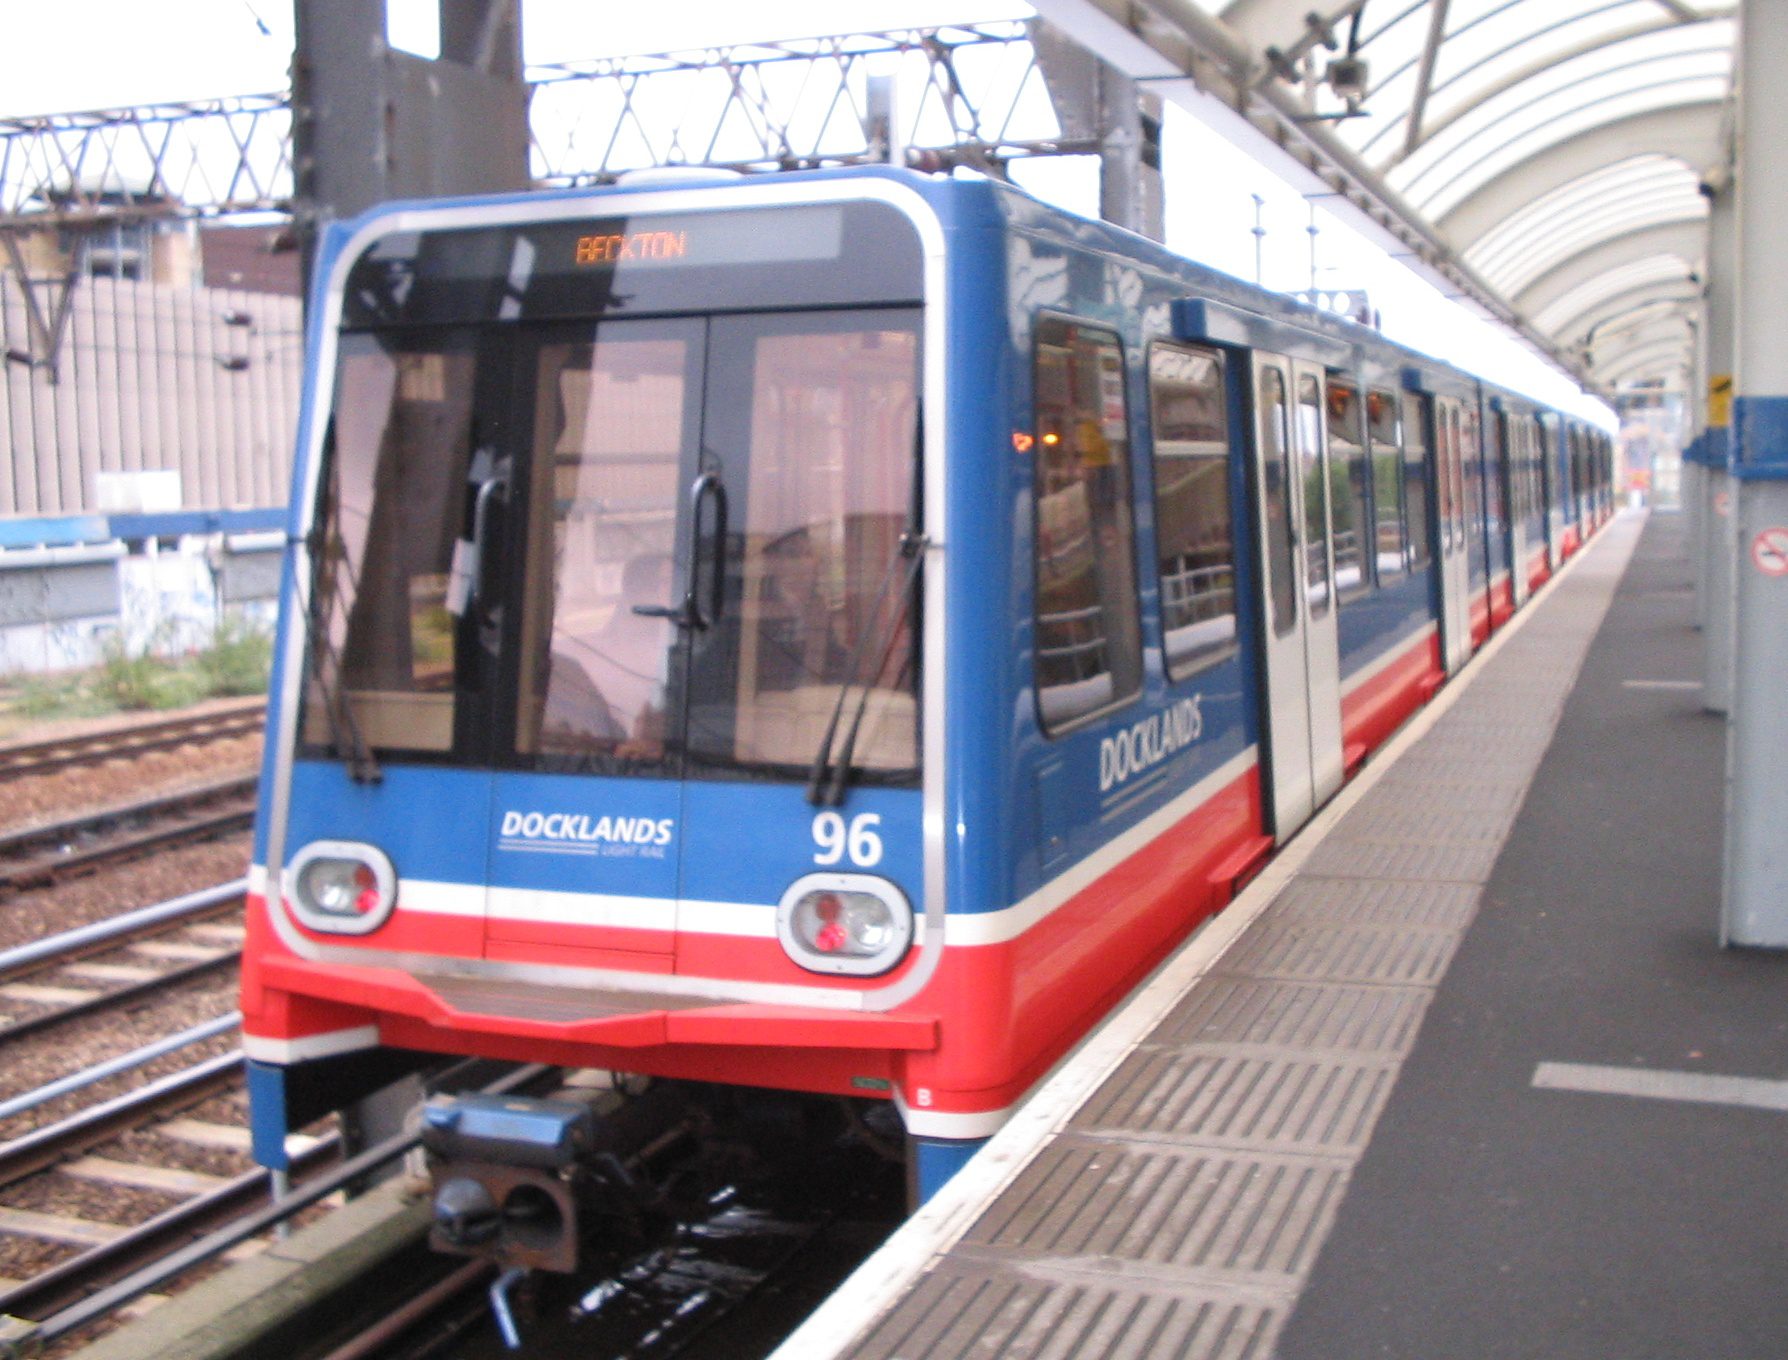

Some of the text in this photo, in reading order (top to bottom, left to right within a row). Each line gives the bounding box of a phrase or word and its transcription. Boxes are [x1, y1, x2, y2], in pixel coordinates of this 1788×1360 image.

[576, 231, 687, 265] BECKTON
[1100, 693, 1202, 792] DOCKLANDS
[501, 811, 674, 845] DOCKLANDS
[811, 811, 883, 867] 96
